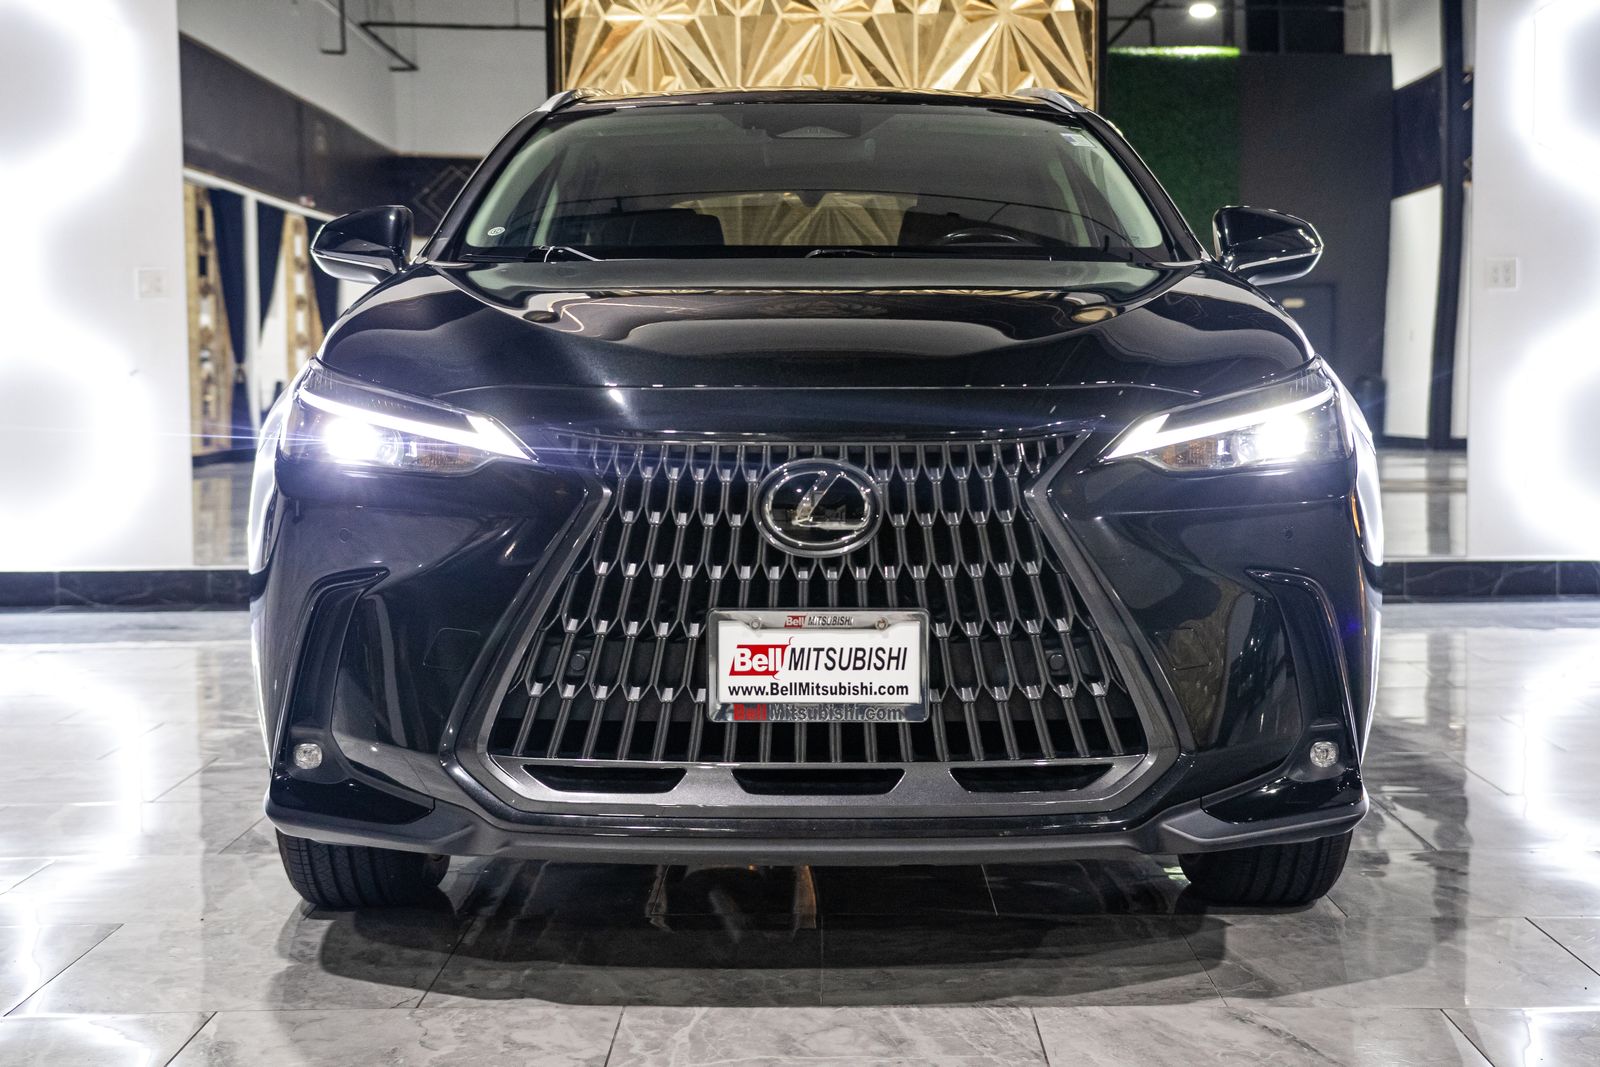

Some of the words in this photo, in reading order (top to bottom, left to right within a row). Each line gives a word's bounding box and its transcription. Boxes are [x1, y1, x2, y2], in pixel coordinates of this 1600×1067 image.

[785, 615, 806, 627] Bell
[808, 615, 854, 626] MITSUBISHI
[731, 644, 788, 675] Bell
[788, 647, 908, 671] MITSUBISHI
[728, 682, 909, 696] www.BellMitsubishi.com
